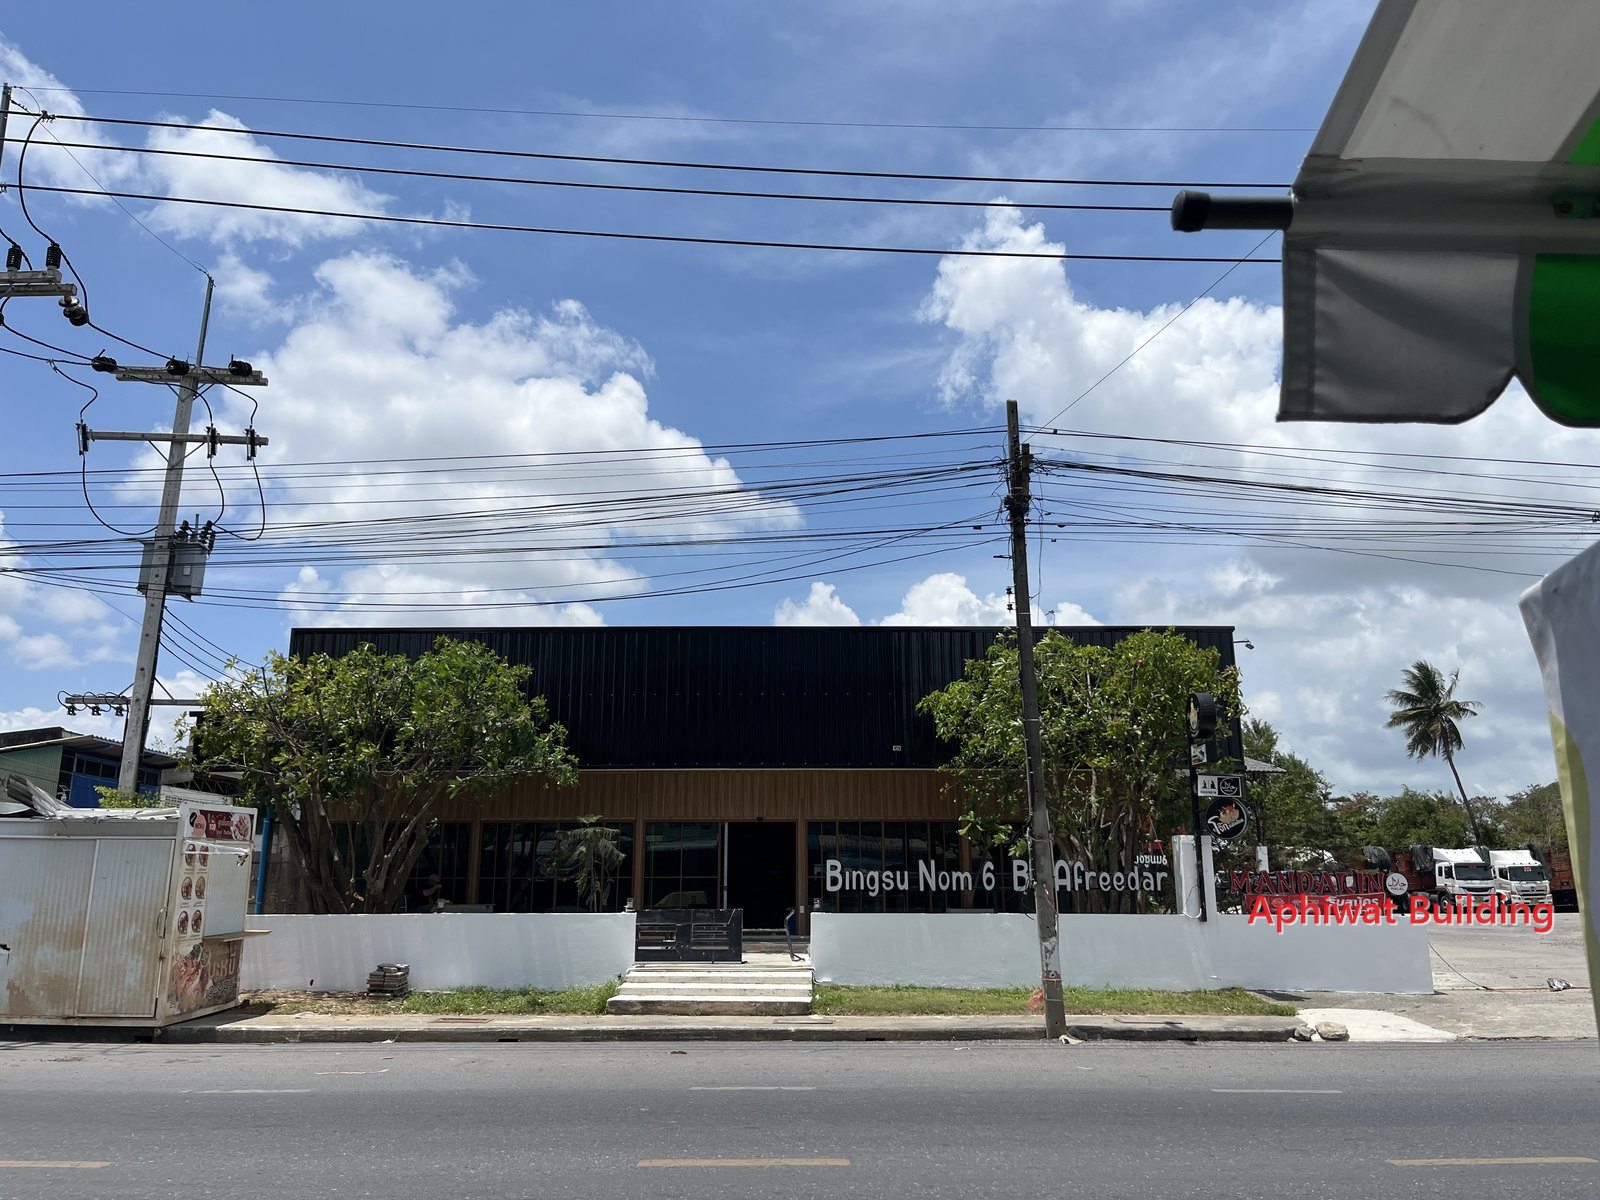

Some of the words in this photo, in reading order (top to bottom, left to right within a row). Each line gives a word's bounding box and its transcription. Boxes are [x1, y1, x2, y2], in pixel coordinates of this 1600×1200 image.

[918, 859, 973, 892] Nom
[982, 860, 996, 892] 6
[1054, 859, 1168, 892] Afreedar
[1228, 870, 1385, 895] MANDARIN
